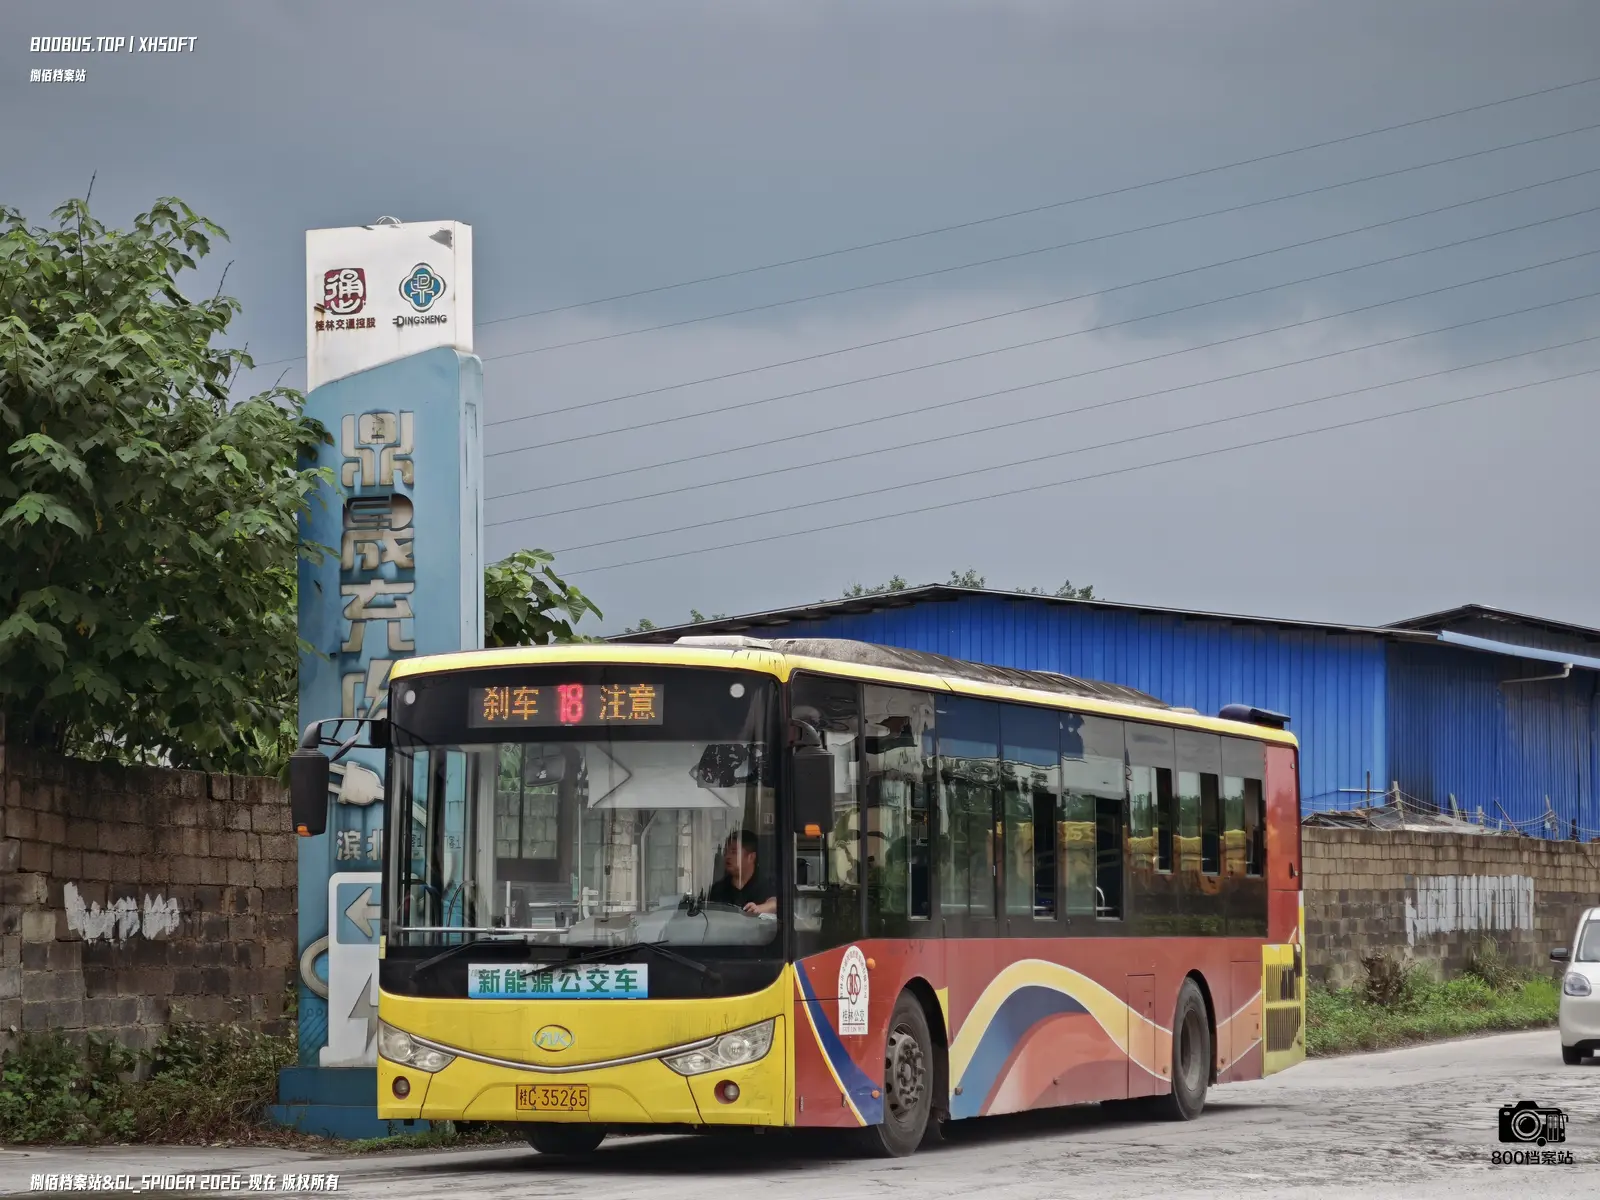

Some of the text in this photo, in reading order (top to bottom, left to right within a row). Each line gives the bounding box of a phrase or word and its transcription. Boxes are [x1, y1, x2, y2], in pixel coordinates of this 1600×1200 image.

[315, 317, 376, 331] 桂林交通控股
[483, 684, 656, 723] 刹车 18 注意
[478, 969, 638, 993] 新能源公交车
[842, 1009, 865, 1022] 桂林公交
